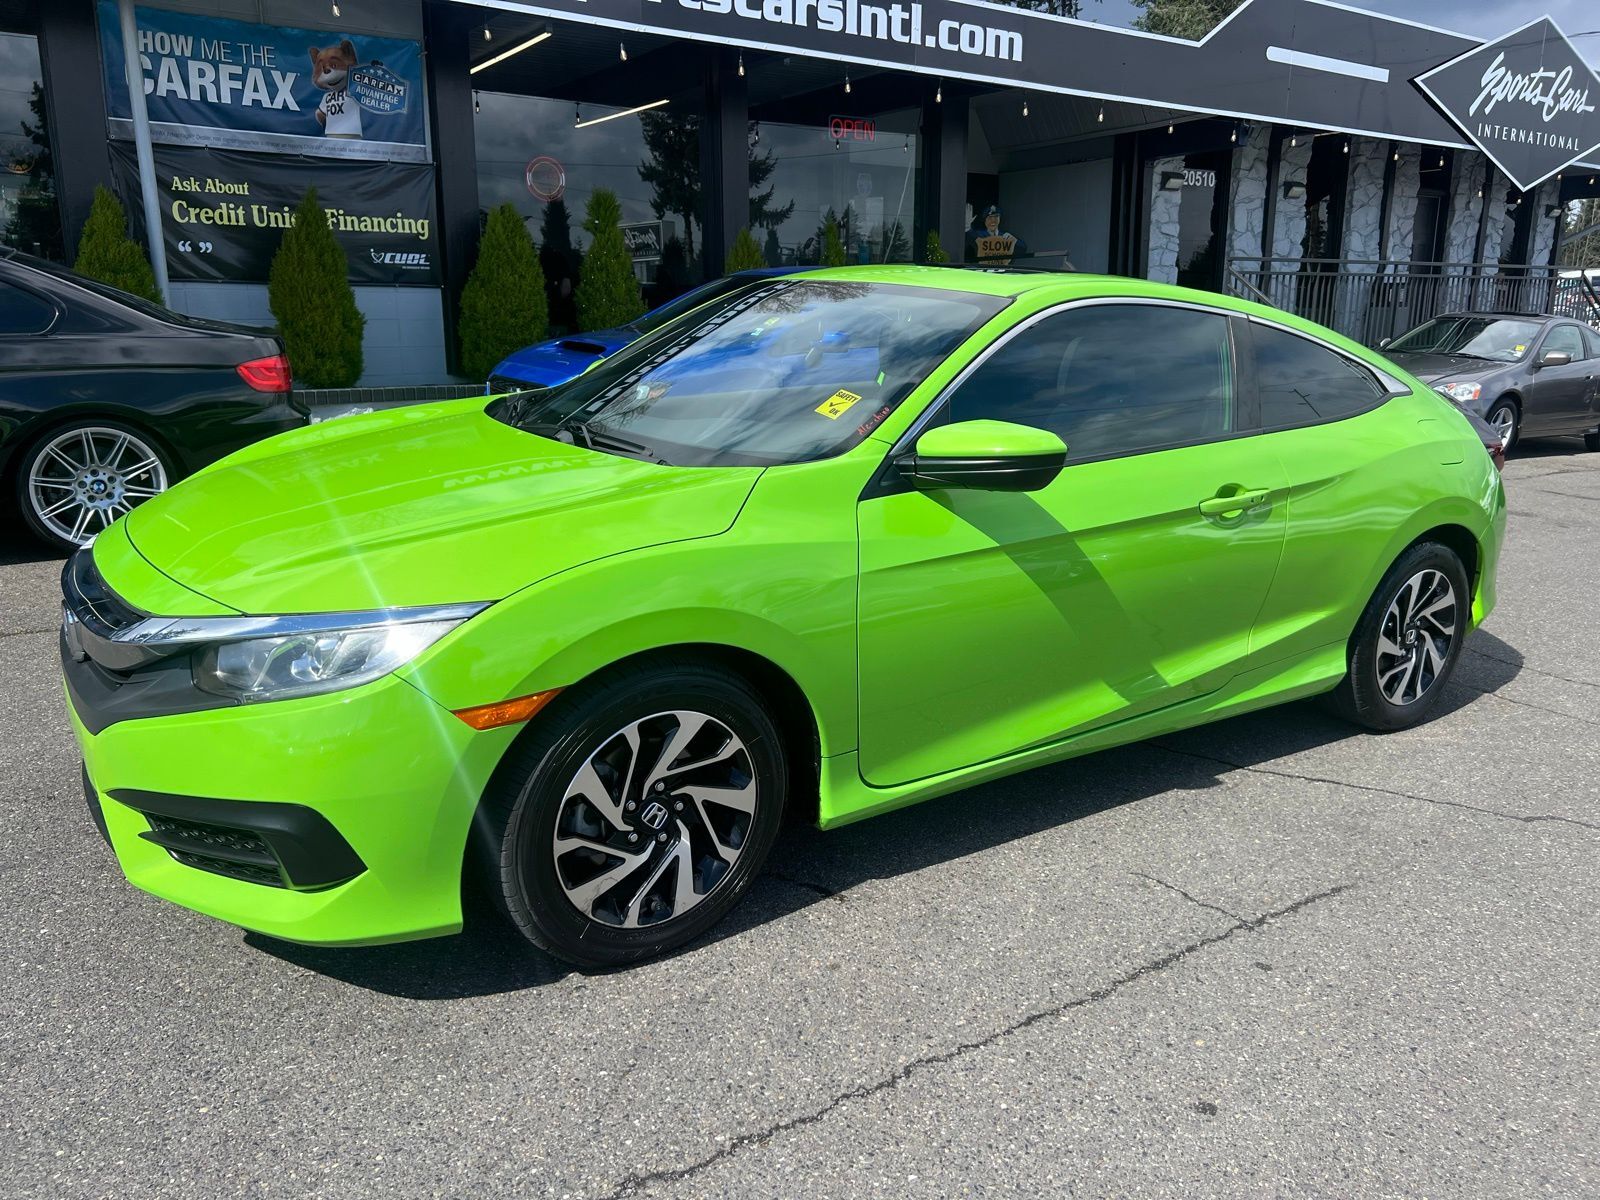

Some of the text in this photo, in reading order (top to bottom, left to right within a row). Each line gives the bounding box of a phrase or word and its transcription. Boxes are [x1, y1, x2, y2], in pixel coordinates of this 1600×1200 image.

[138, 30, 277, 68] HOW ME THE
[353, 73, 405, 97] CARFAX
[1469, 51, 1595, 122] Sports Cars
[325, 91, 346, 104] CAR
[356, 86, 399, 105] ADVANTAGE
[361, 96, 391, 111] DEALER
[326, 103, 345, 116] FOX
[831, 118, 876, 141] OPEN
[1478, 123, 1580, 151] INTERNATIONAL
[171, 176, 249, 195] Ask About
[1183, 170, 1216, 187] 20510
[172, 200, 246, 226] Credit
[325, 208, 430, 240] Financing
[982, 240, 1012, 252] SLOW
[836, 391, 859, 403] SAFETY
[829, 408, 840, 416] OK
